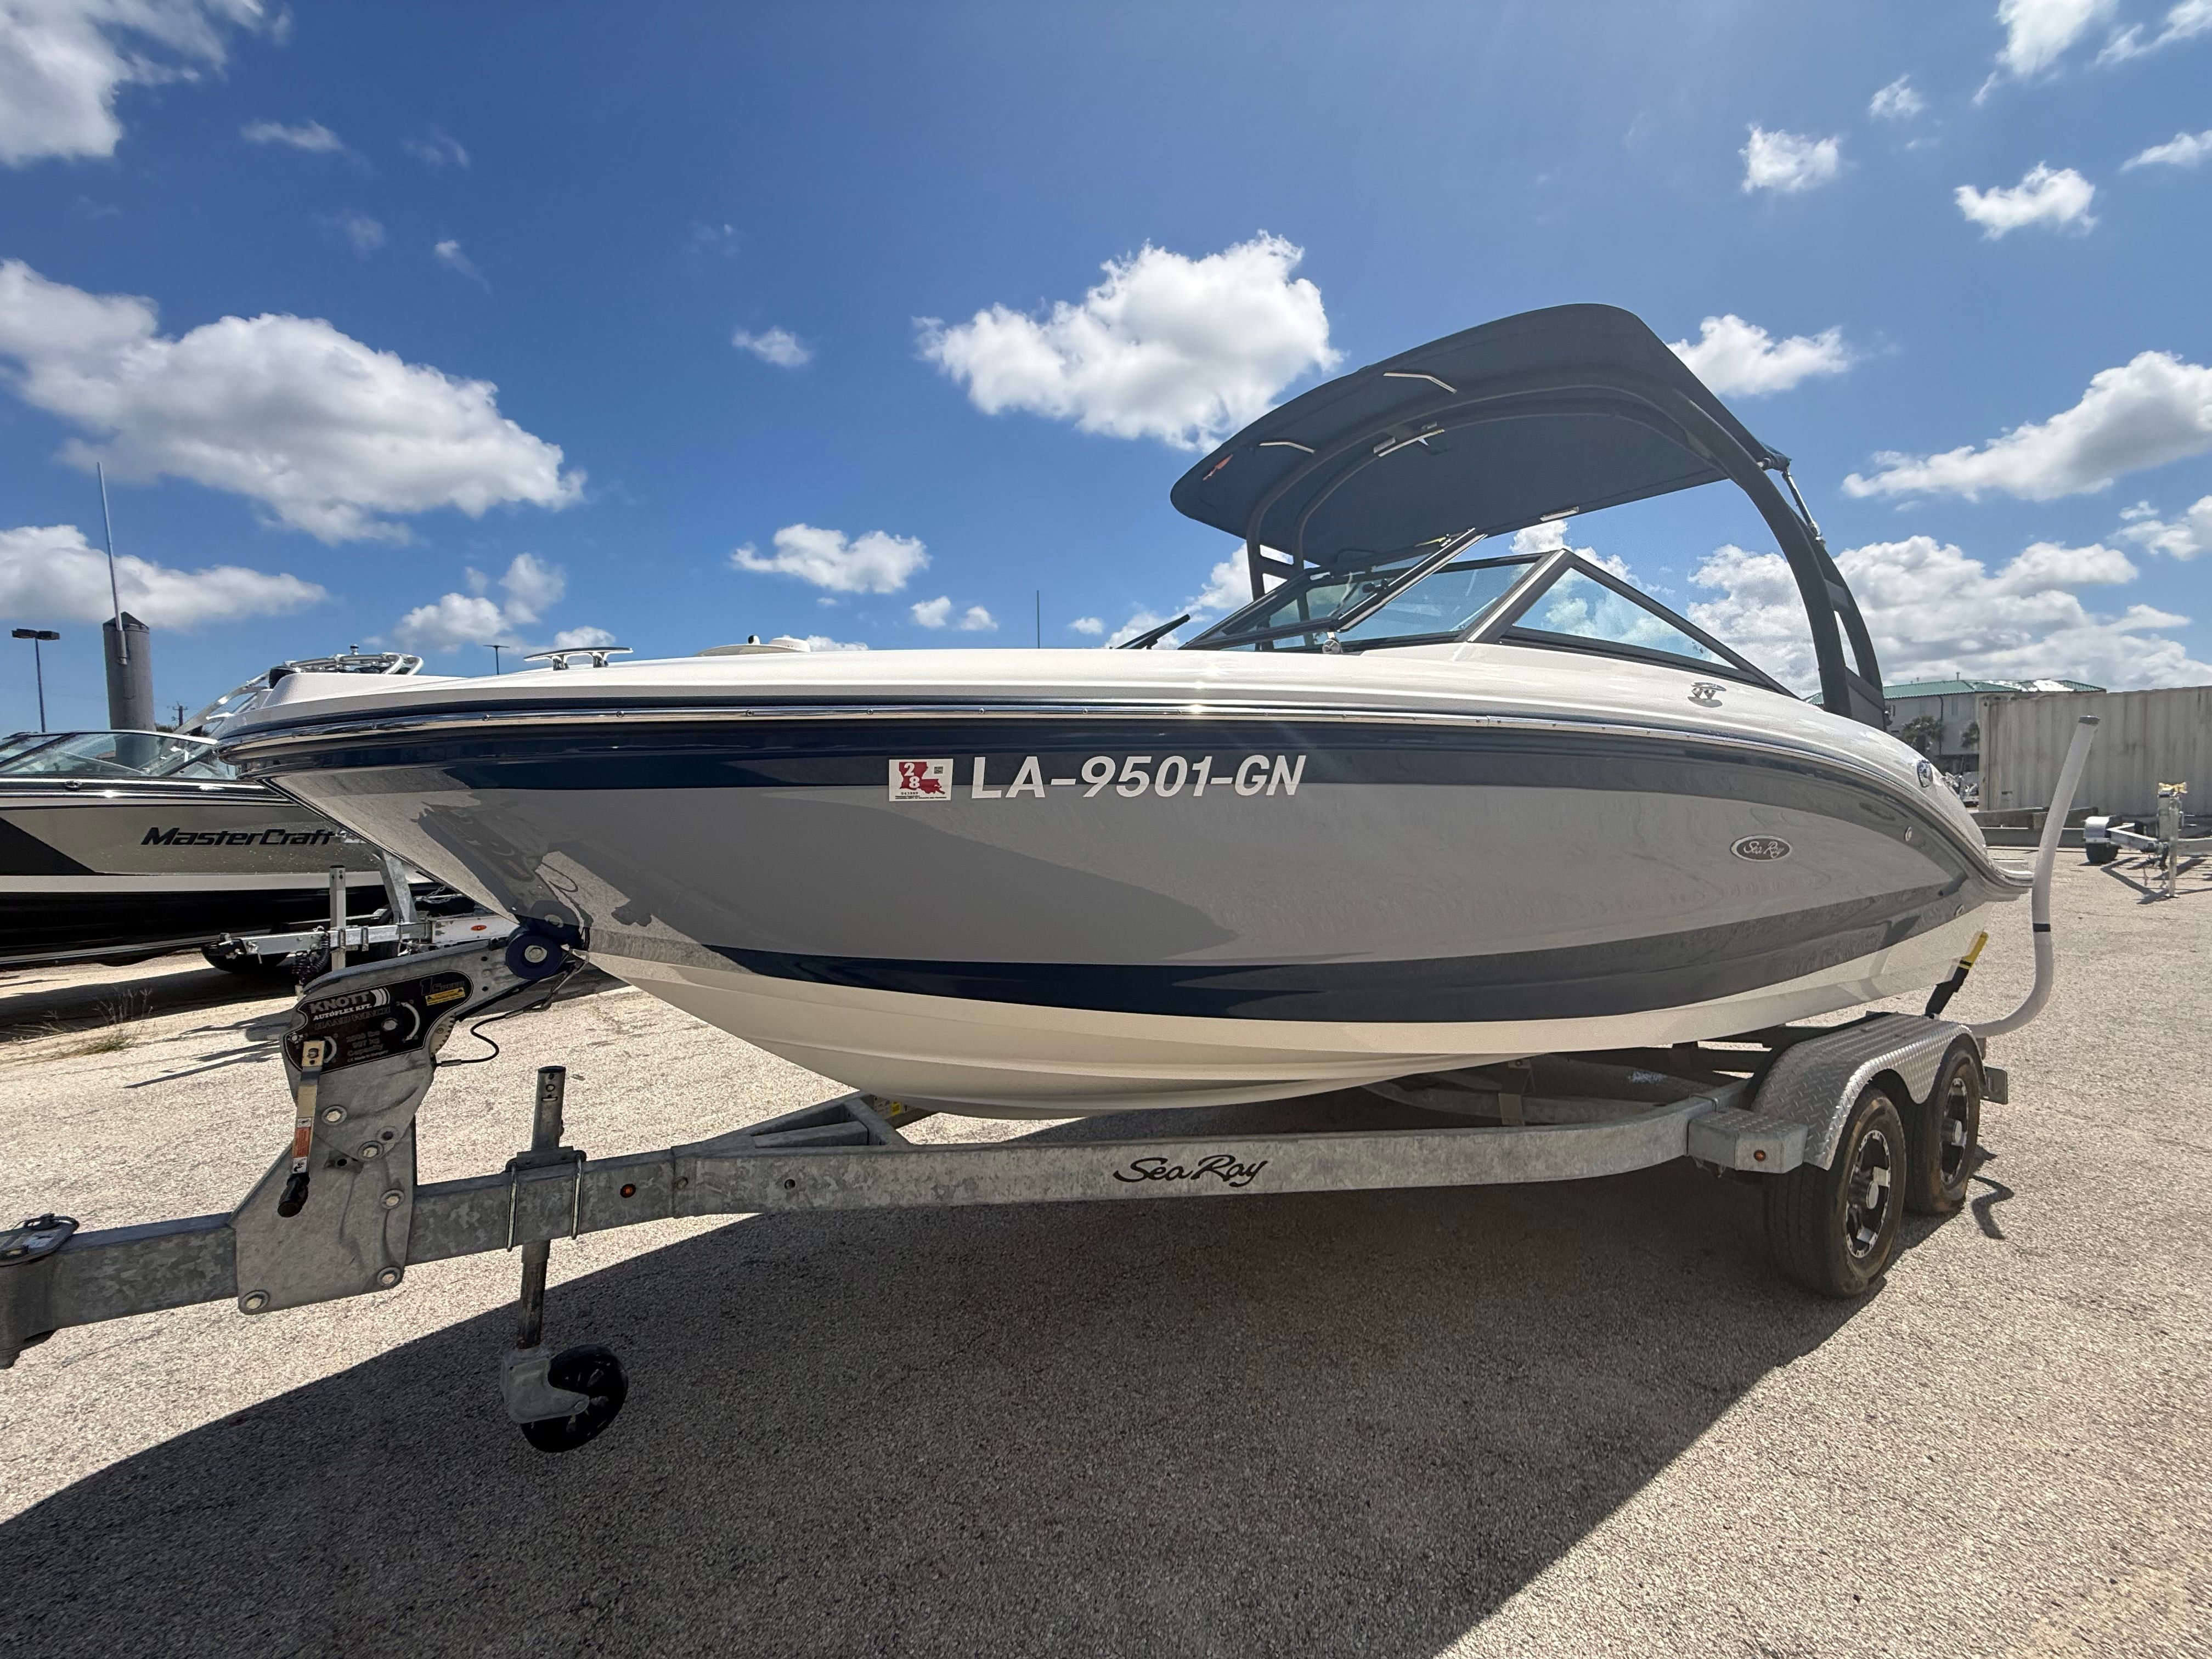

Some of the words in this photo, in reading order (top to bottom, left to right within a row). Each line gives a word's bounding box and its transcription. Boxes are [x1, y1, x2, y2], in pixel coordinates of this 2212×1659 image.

[904, 762, 915, 776] 2
[972, 754, 1306, 799] LA-9501-GN
[909, 776, 920, 788] 8
[140, 827, 335, 845] MasterCraft
[1743, 840, 1763, 854] Sea
[308, 991, 370, 1014] KNOTT
[1113, 1157, 1193, 1183] Sea
[1190, 1154, 1268, 1188] Ray
